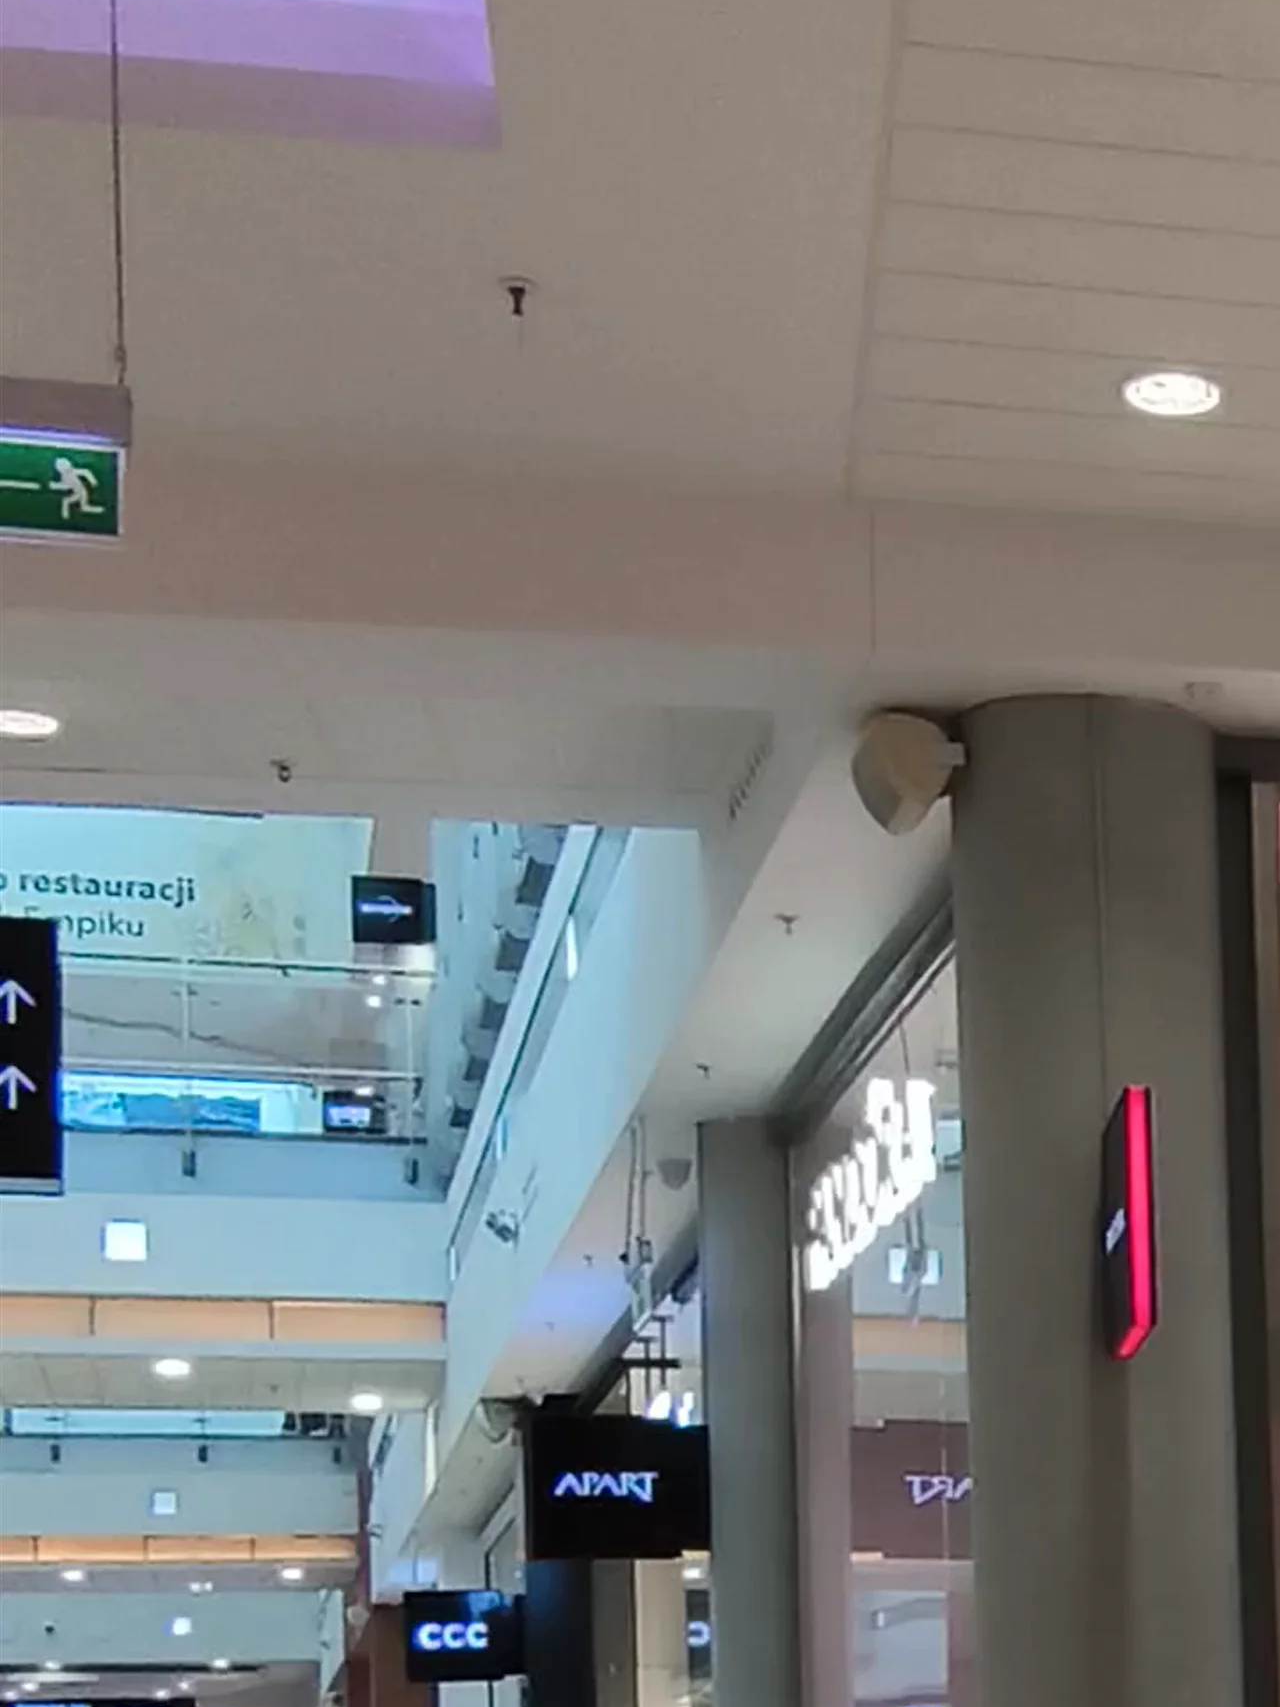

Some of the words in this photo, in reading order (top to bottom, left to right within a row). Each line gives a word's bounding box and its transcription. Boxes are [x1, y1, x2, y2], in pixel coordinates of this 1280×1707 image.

[19, 873, 195, 908] restauracji
[554, 1471, 659, 1503] APART
[418, 1622, 489, 1651] CCC
